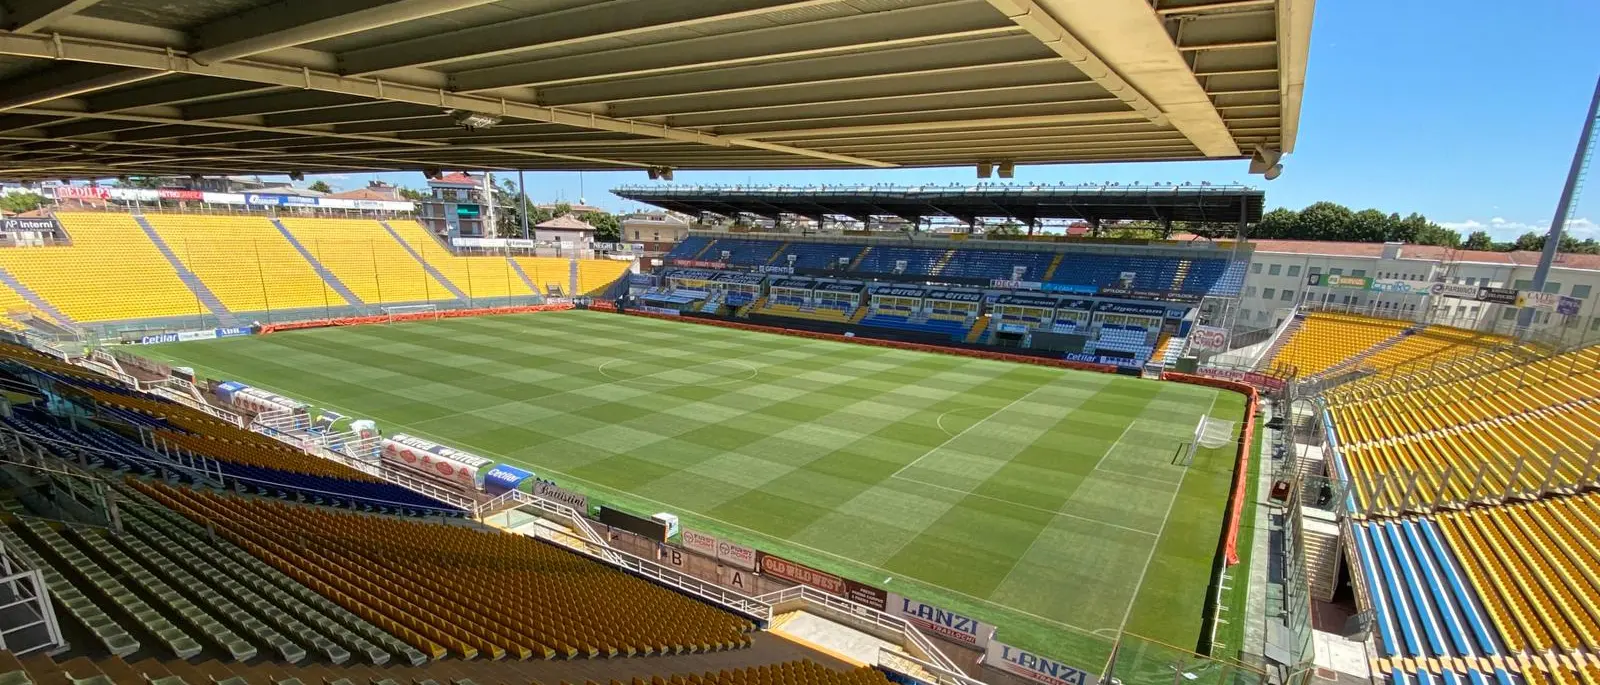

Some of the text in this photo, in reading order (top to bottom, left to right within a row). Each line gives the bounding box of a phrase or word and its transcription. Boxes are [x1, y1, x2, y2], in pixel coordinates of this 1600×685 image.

[142, 333, 178, 345] Cetilar
[1066, 352, 1096, 362] Cetilar
[487, 468, 520, 483] Cetilar
[540, 482, 585, 507] Battistini
[672, 550, 681, 565] B
[732, 572, 743, 588] A
[766, 556, 843, 593] OLD WILD WEST
[903, 598, 979, 636] LANZI
[930, 623, 977, 645] TRASLOCHI
[1002, 645, 1088, 685] LANZI
